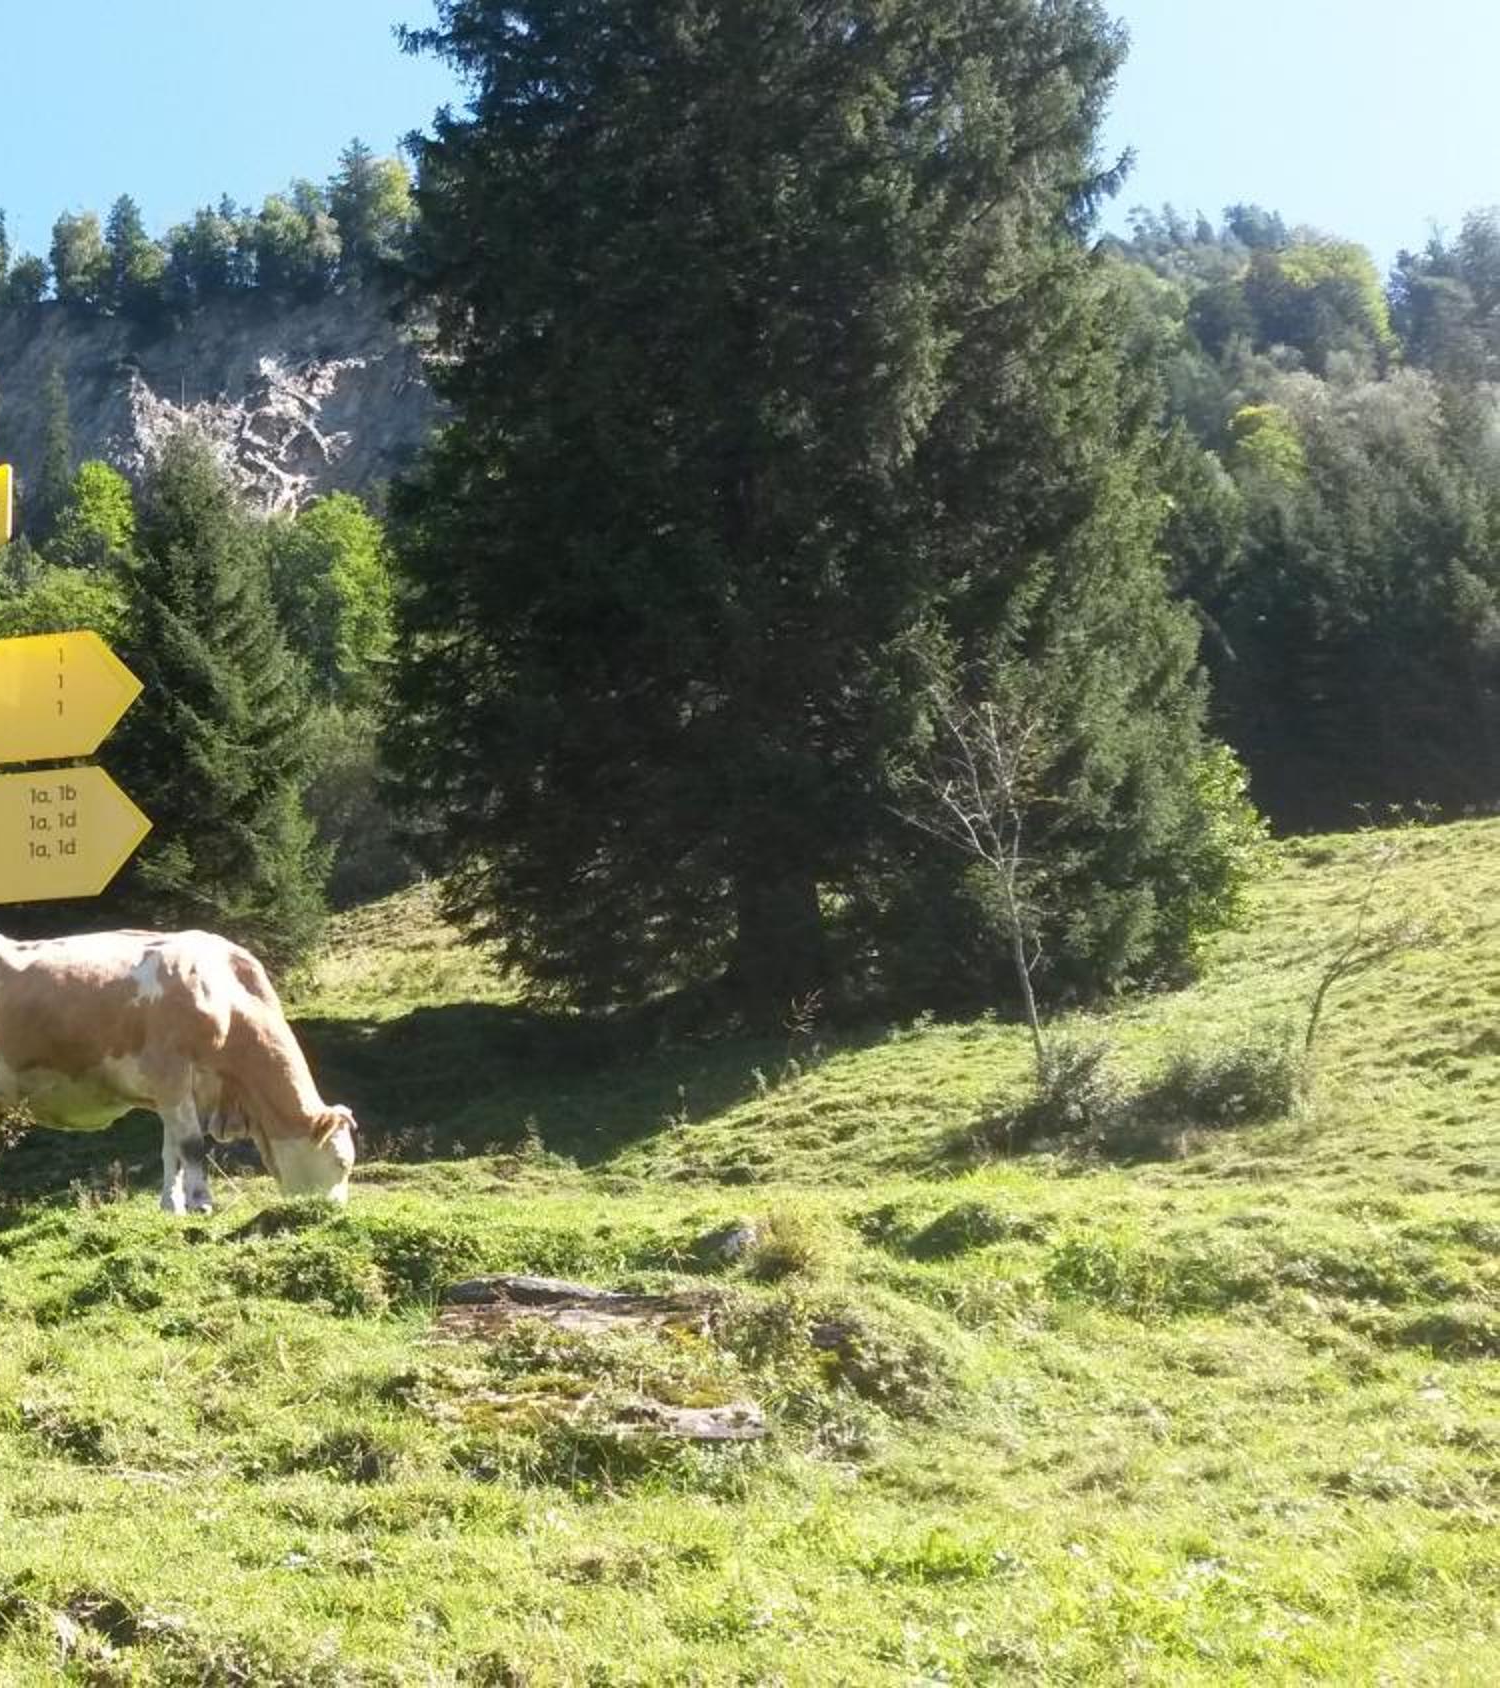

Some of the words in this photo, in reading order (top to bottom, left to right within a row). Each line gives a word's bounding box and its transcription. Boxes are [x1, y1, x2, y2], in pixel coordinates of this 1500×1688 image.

[57, 648, 64, 665] 1
[57, 674, 64, 689] 1
[56, 700, 64, 716] 1
[31, 788, 52, 804] 1a,
[59, 784, 77, 801] 1b
[30, 815, 52, 831] 1a,
[58, 812, 77, 829] 1d
[29, 842, 52, 859] 1a,
[58, 839, 77, 856] 1d
